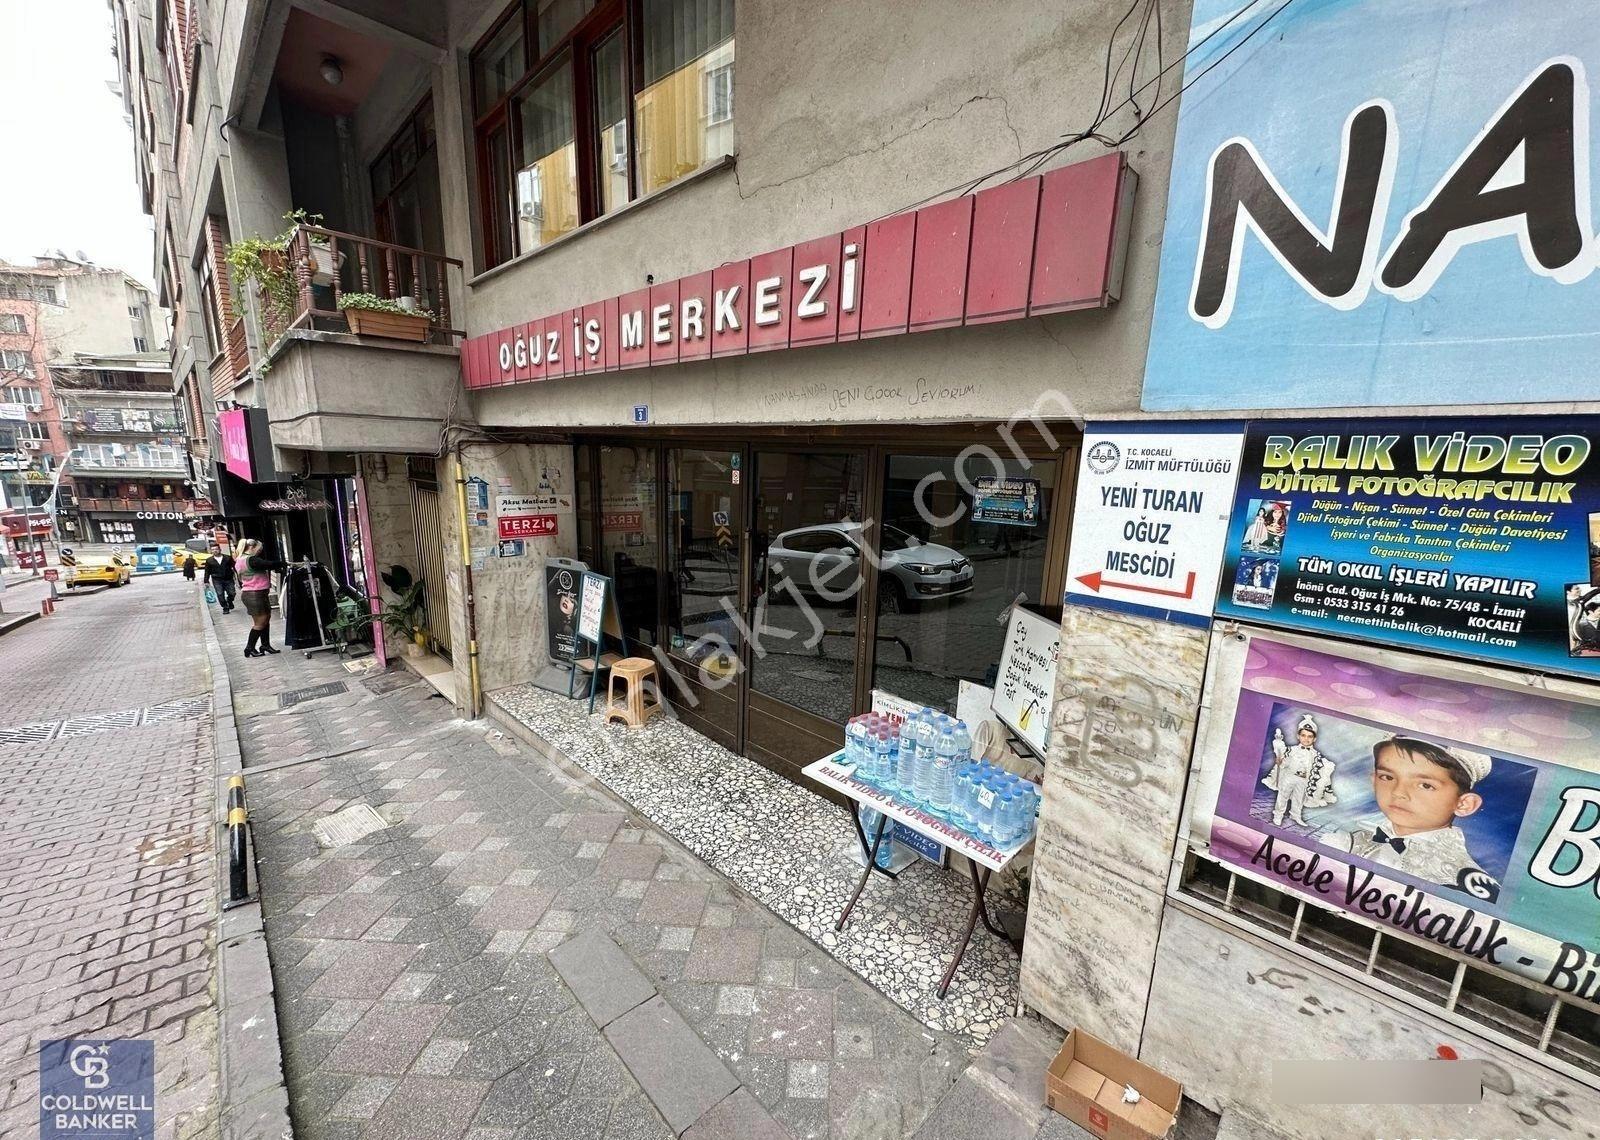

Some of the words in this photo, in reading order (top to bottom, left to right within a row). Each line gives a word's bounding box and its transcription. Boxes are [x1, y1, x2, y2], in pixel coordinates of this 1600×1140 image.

[1189, 54, 1600, 329] NA
[500, 331, 561, 372] OĞUZ
[574, 317, 602, 364] İŞ
[621, 243, 860, 350] MERKEZİ
[1125, 458, 1155, 472] İZMİT
[1158, 458, 1232, 474] MÜFTÜLÜĞÜ
[1127, 448, 1139, 456] T.C.
[1141, 447, 1172, 457] KOCAELİ
[1263, 436, 1400, 471] BALIK
[1414, 432, 1591, 476] VİDEO
[1101, 482, 1138, 509] YENİ
[1142, 488, 1204, 514] TURAN
[1260, 470, 1341, 494] DİJİTAL
[1348, 474, 1576, 504] FOTOĞRAFCILIK
[136, 512, 183, 520] COTTON
[502, 518, 545, 530] TERZİ
[1312, 500, 1342, 512] Düğün
[1352, 502, 1380, 514] Nişan
[1390, 504, 1428, 515] Sünnet
[1438, 504, 1465, 518] Özel
[1466, 508, 1490, 520] Gün
[1494, 509, 1554, 523] Çekimleri
[1123, 516, 1172, 545] OĞUZ
[1324, 514, 1365, 526] Fotoğraf
[1366, 516, 1401, 528] Çekimi
[1410, 520, 1448, 532] Sünnet
[1459, 523, 1498, 536] Düğün
[1500, 526, 1568, 541] Davetiyesi
[1330, 526, 1358, 540] İşyeri
[1358, 532, 1370, 540] ve
[1372, 532, 1410, 544] Fabrika
[1413, 535, 1452, 548] Tanıtım
[1455, 538, 1512, 552] Çekimleri
[1106, 550, 1176, 579] MESCİDİ
[1370, 546, 1454, 562] Organizasyonlar
[1298, 556, 1334, 574] TÜM
[1338, 562, 1383, 580] OKUL
[1388, 565, 1448, 588] İŞLERİ
[1454, 574, 1536, 598] YAPILIR
[1294, 593, 1314, 604] Gsm
[1324, 597, 1349, 608] 0533
[1351, 600, 1372, 612] 315
[1374, 604, 1386, 614] 41
[1390, 606, 1404, 617] 26
[1296, 578, 1324, 592] İnönü
[1326, 584, 1348, 596] Cad.
[1351, 588, 1378, 600] Oğuz
[1380, 588, 1390, 604] İş
[1392, 592, 1418, 605] Mrk.
[1420, 596, 1441, 608] No:
[1444, 598, 1480, 612] 75/48
[1492, 602, 1526, 618] İzmit
[1291, 607, 1328, 618] e-mail:
[1337, 614, 1516, 648] necmettinbalik@hotmail.com
[1468, 616, 1522, 633] KOCAELİ
[1528, 786, 1600, 900] B
[1251, 835, 1334, 893] Acele
[1344, 864, 1508, 965] Vesikalık
[1544, 941, 1600, 1001] Bi
